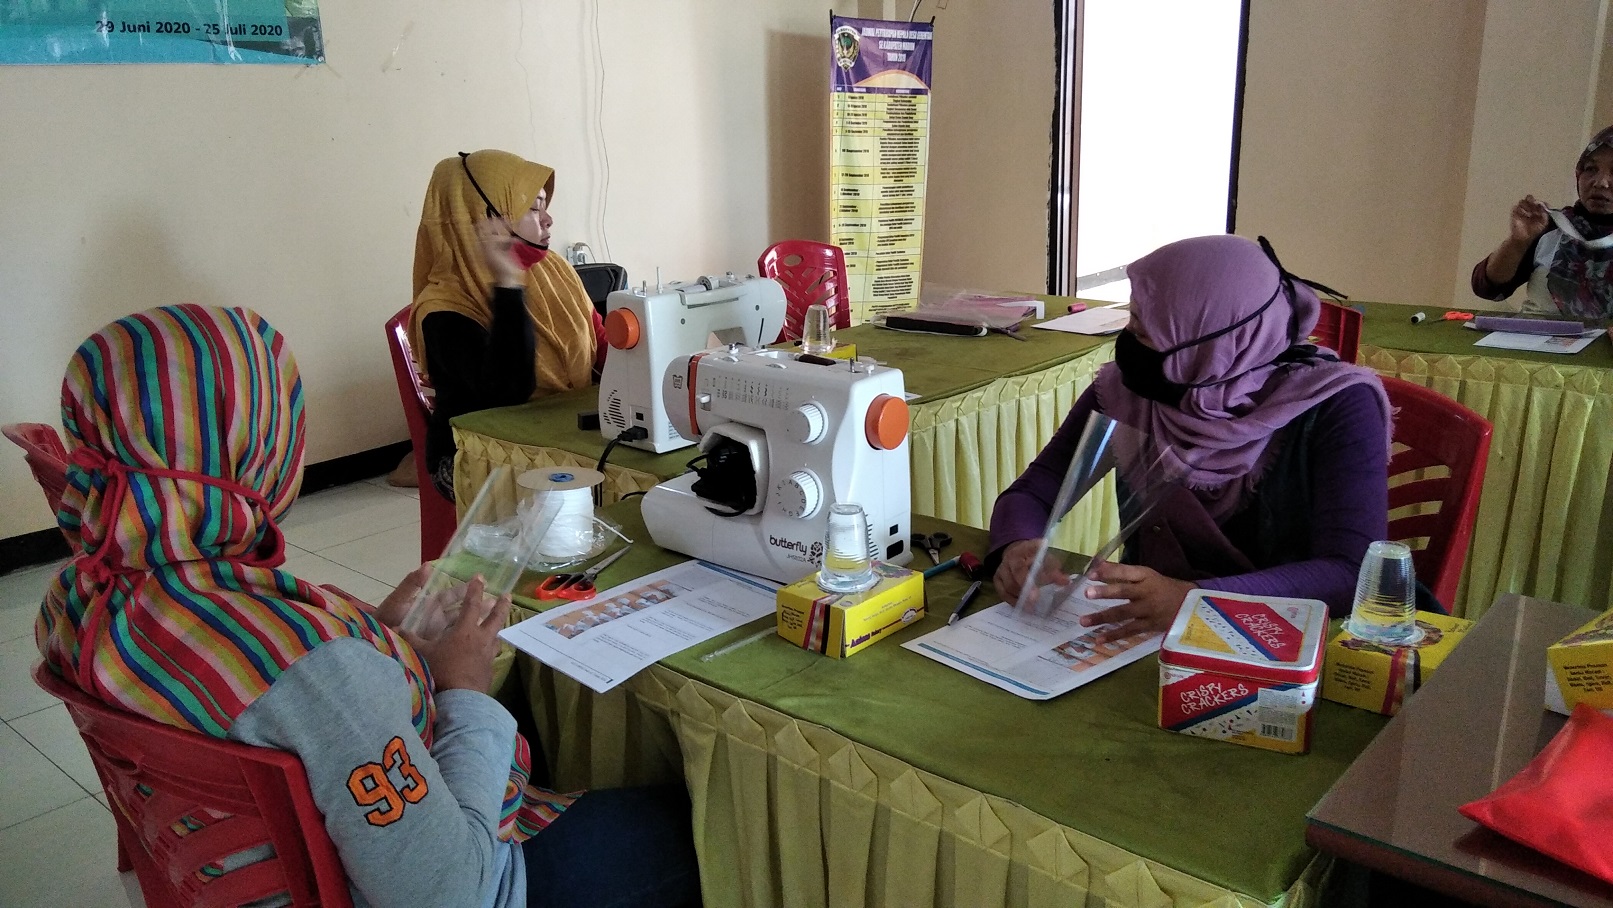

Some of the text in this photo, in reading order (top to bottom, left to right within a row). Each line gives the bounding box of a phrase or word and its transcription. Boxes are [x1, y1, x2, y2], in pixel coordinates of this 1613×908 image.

[95, 20, 114, 33] 29
[120, 20, 151, 33] Juni
[155, 21, 191, 34] 2020
[203, 23, 220, 35] 25
[250, 24, 283, 36] 2020
[769, 534, 808, 556] butterfly
[1234, 613, 1287, 649] CRACKERS
[1251, 613, 1284, 635] CRISPY
[1179, 682, 1223, 704] CRISPY
[1180, 683, 1249, 715] CRACKERS
[346, 735, 429, 828] 93
